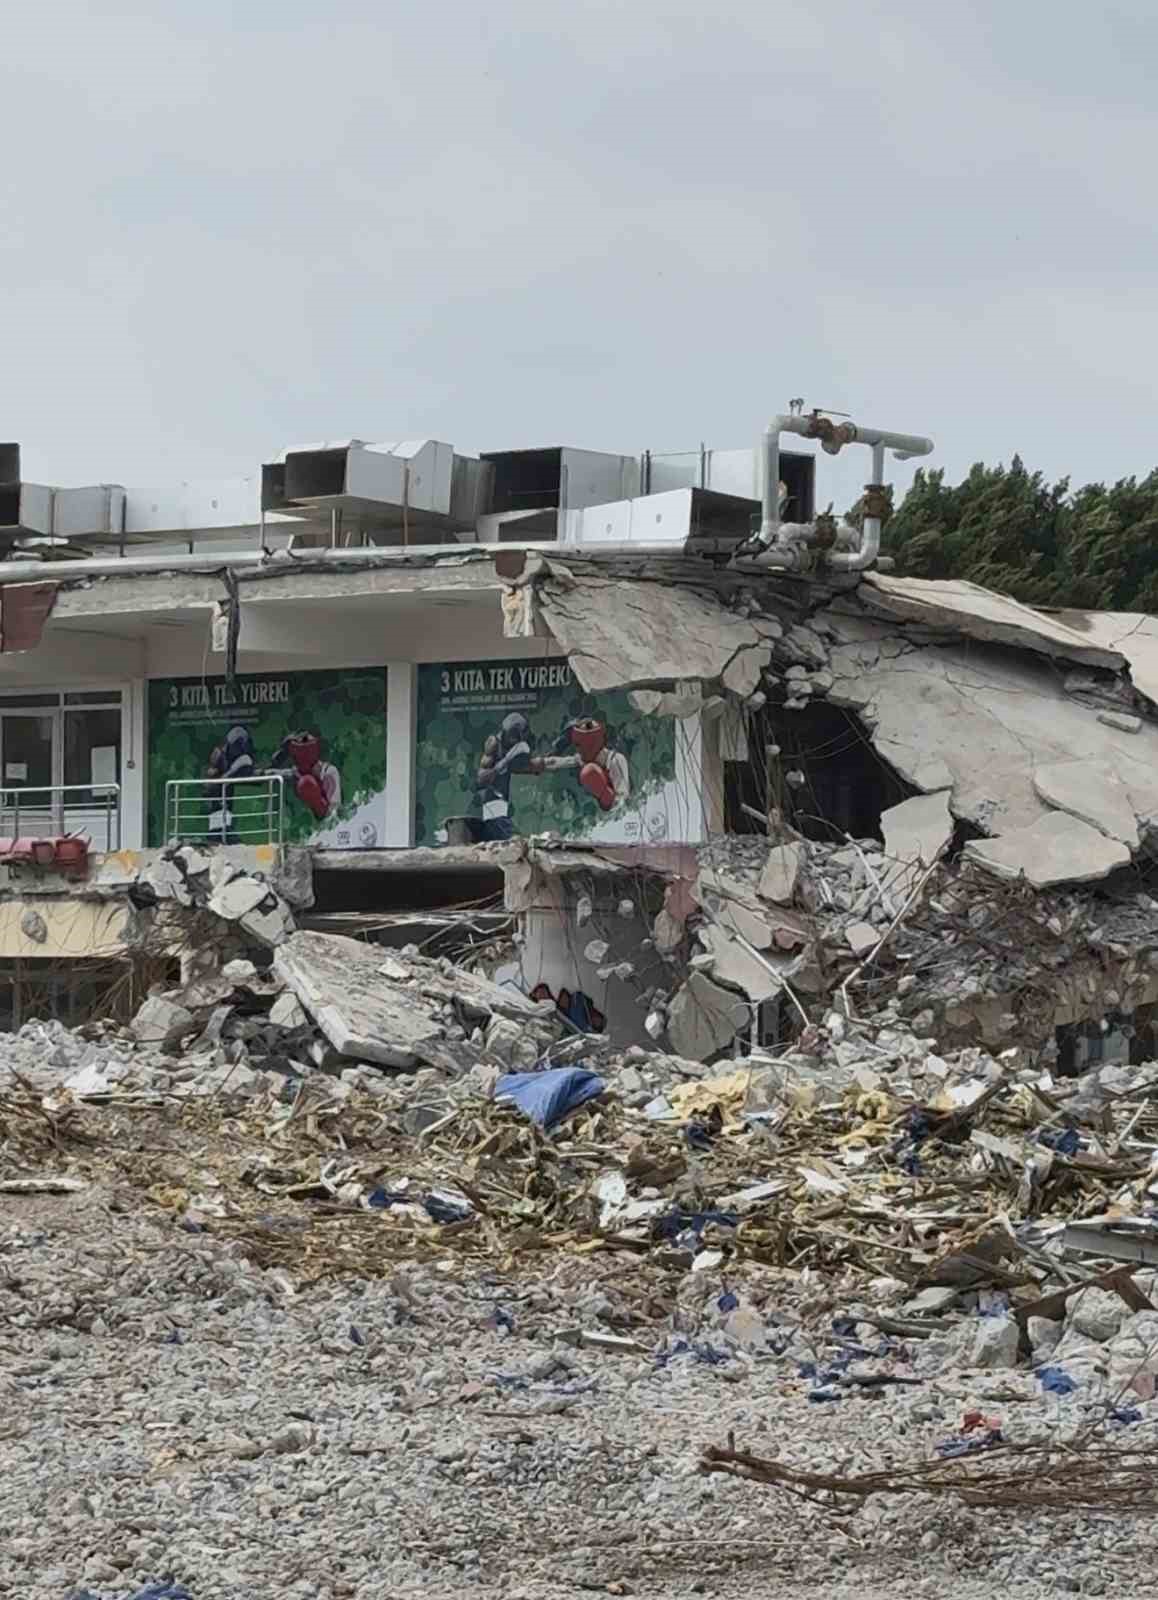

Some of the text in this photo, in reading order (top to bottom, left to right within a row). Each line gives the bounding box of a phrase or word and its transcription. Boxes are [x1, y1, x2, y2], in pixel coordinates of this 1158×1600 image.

[441, 671, 450, 692] 3
[454, 669, 485, 691] KITA
[488, 667, 514, 690] TEK
[169, 686, 178, 707] 3
[181, 686, 210, 706] KITA
